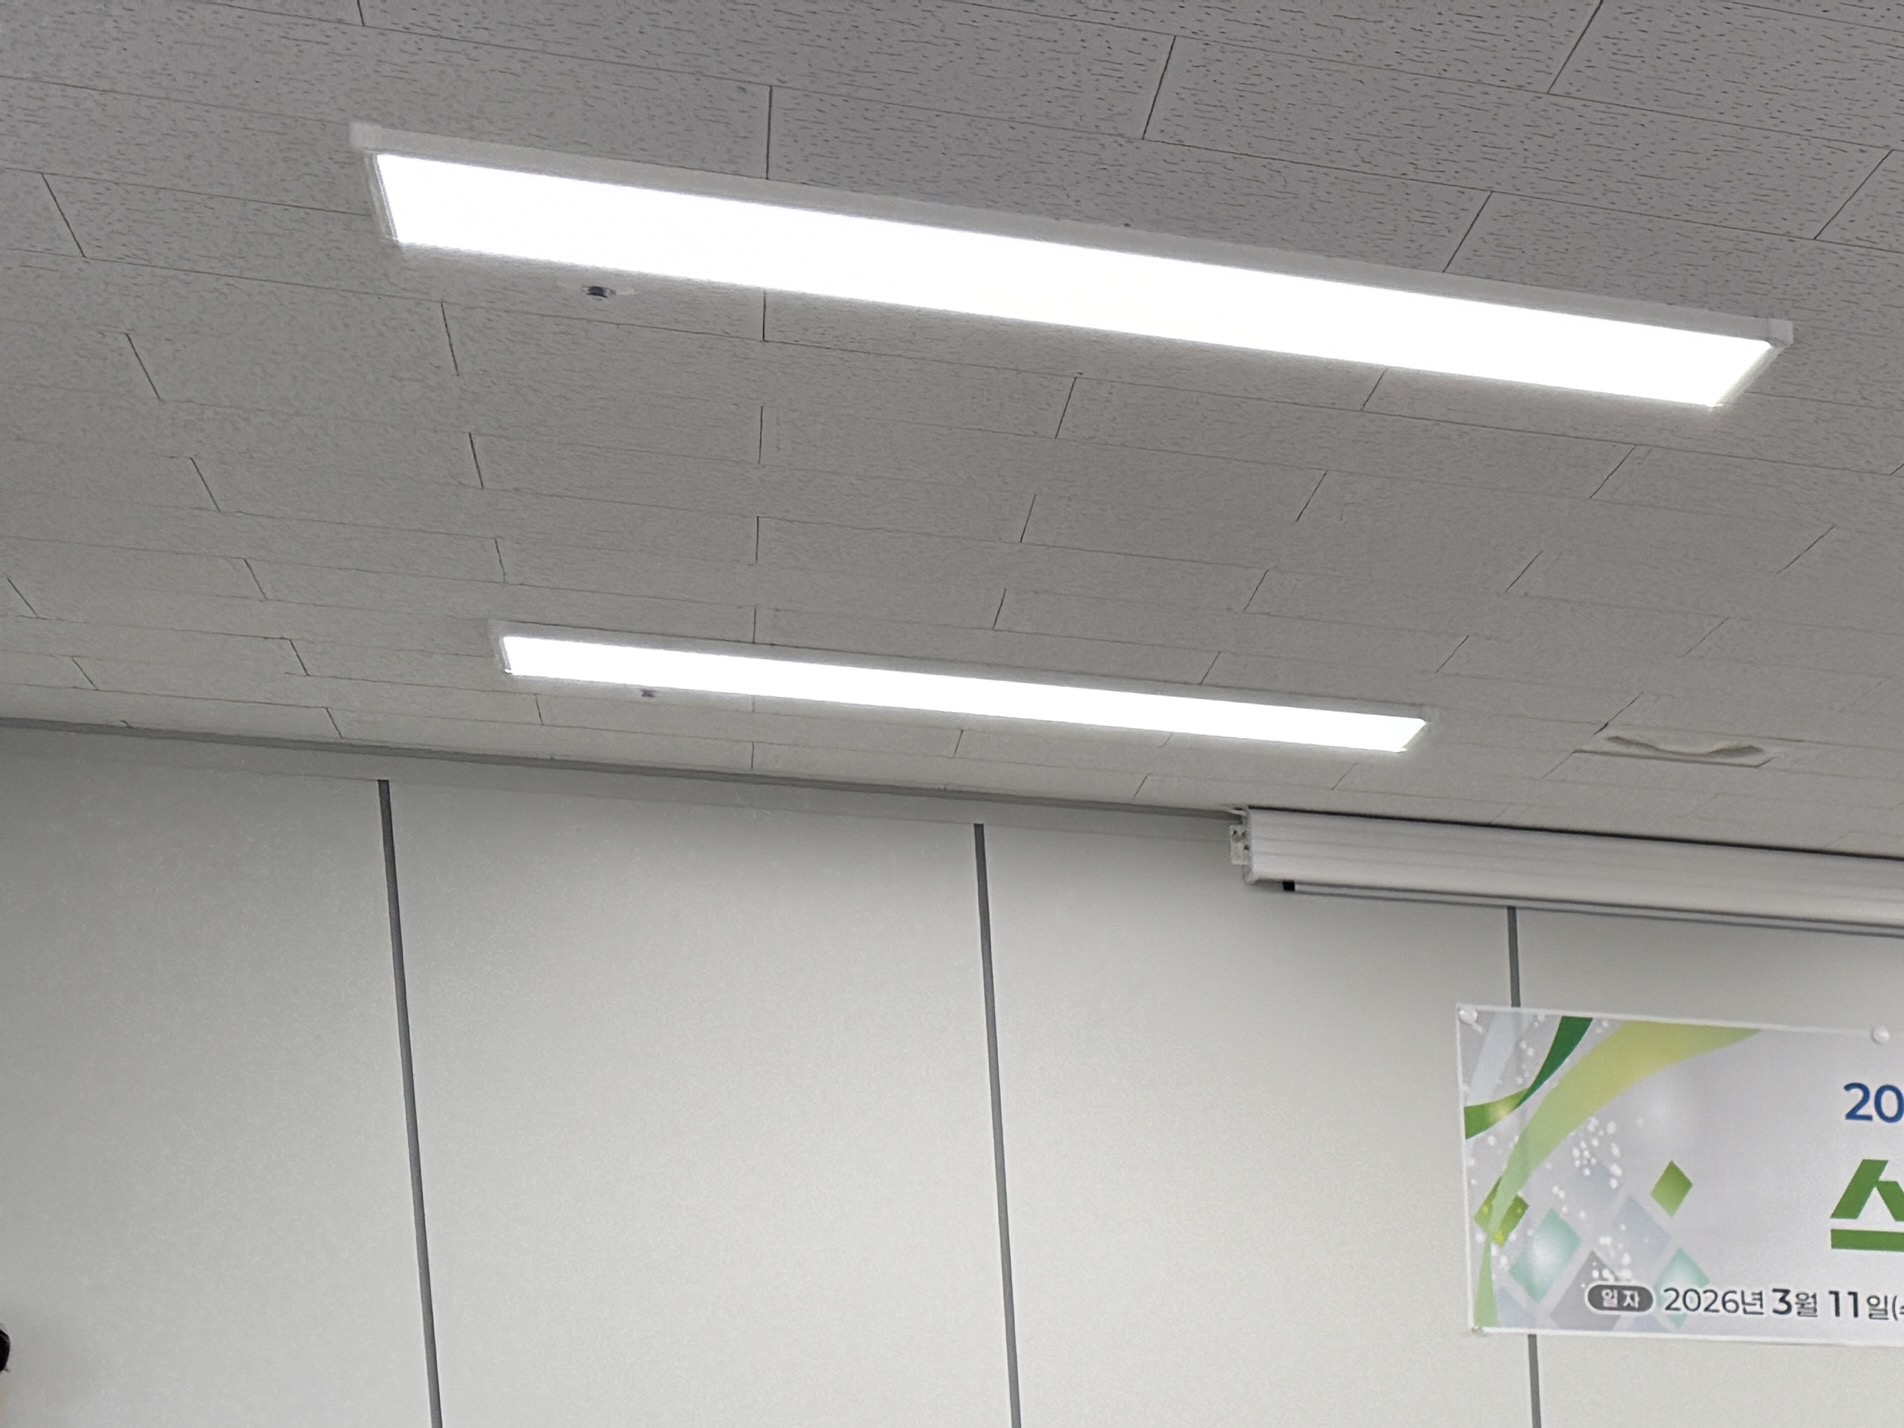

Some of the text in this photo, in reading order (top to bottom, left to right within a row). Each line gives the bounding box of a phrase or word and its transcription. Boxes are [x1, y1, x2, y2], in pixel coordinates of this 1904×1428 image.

[1601, 1288, 1641, 1309] 일자
[1663, 1287, 1765, 1317] 2026년
[1771, 1288, 1819, 1319] 3월
